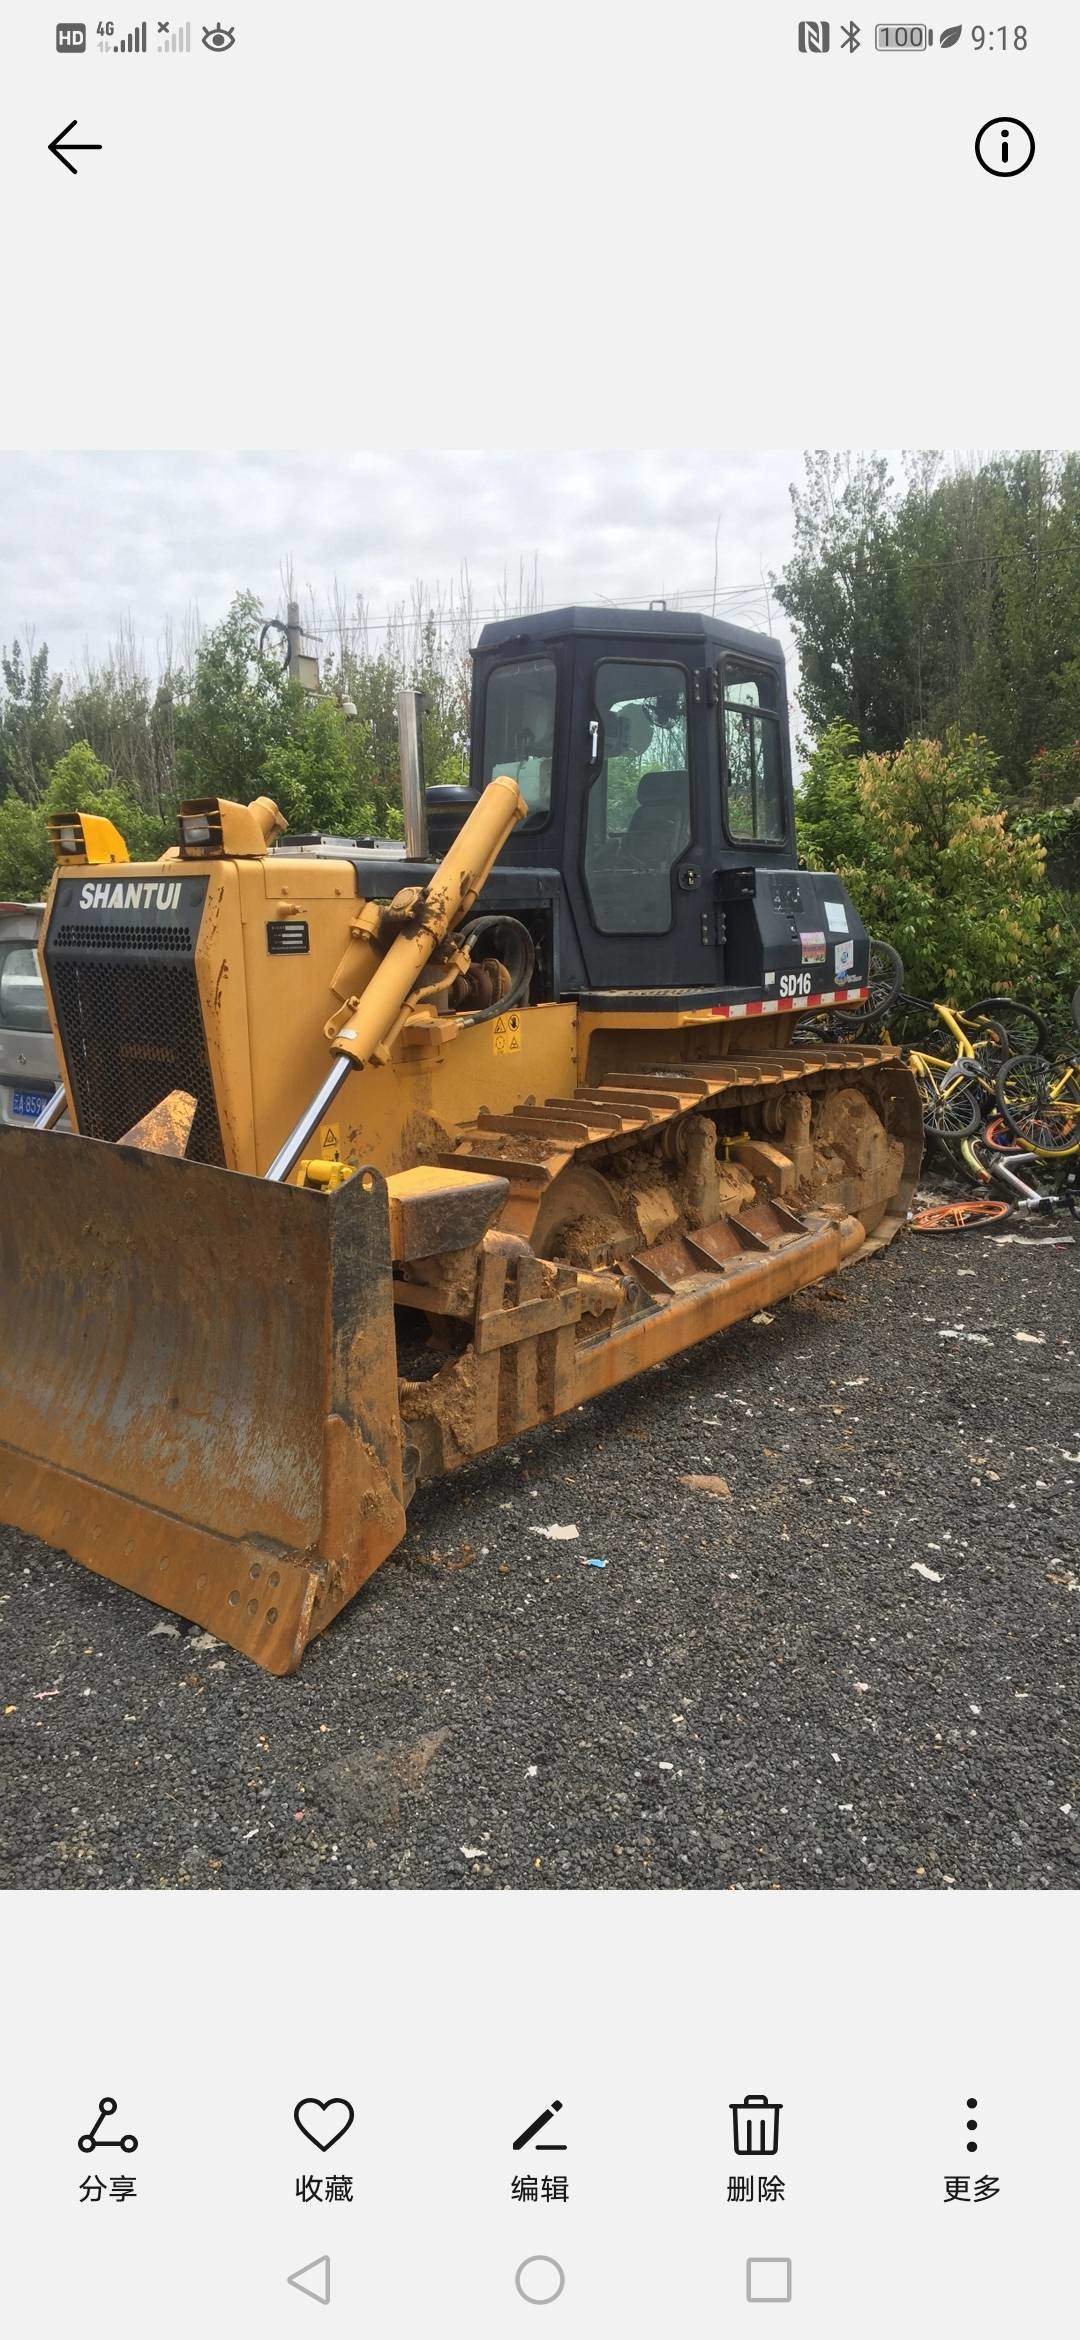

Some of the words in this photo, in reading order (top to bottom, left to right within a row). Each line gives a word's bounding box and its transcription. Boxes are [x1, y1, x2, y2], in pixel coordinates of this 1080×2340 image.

[58, 30, 84, 46] HD
[96, 21, 115, 37] 4G
[880, 27, 923, 47] 100
[971, 25, 1028, 51] 9:18
[80, 882, 182, 911] SHANTUI
[780, 972, 811, 998] SD16
[79, 2174, 137, 2203] 分享
[295, 2174, 354, 2203] 收藏
[511, 2174, 570, 2203] 编辑
[727, 2174, 786, 2203] 删除
[943, 2174, 1001, 2203] 更多
